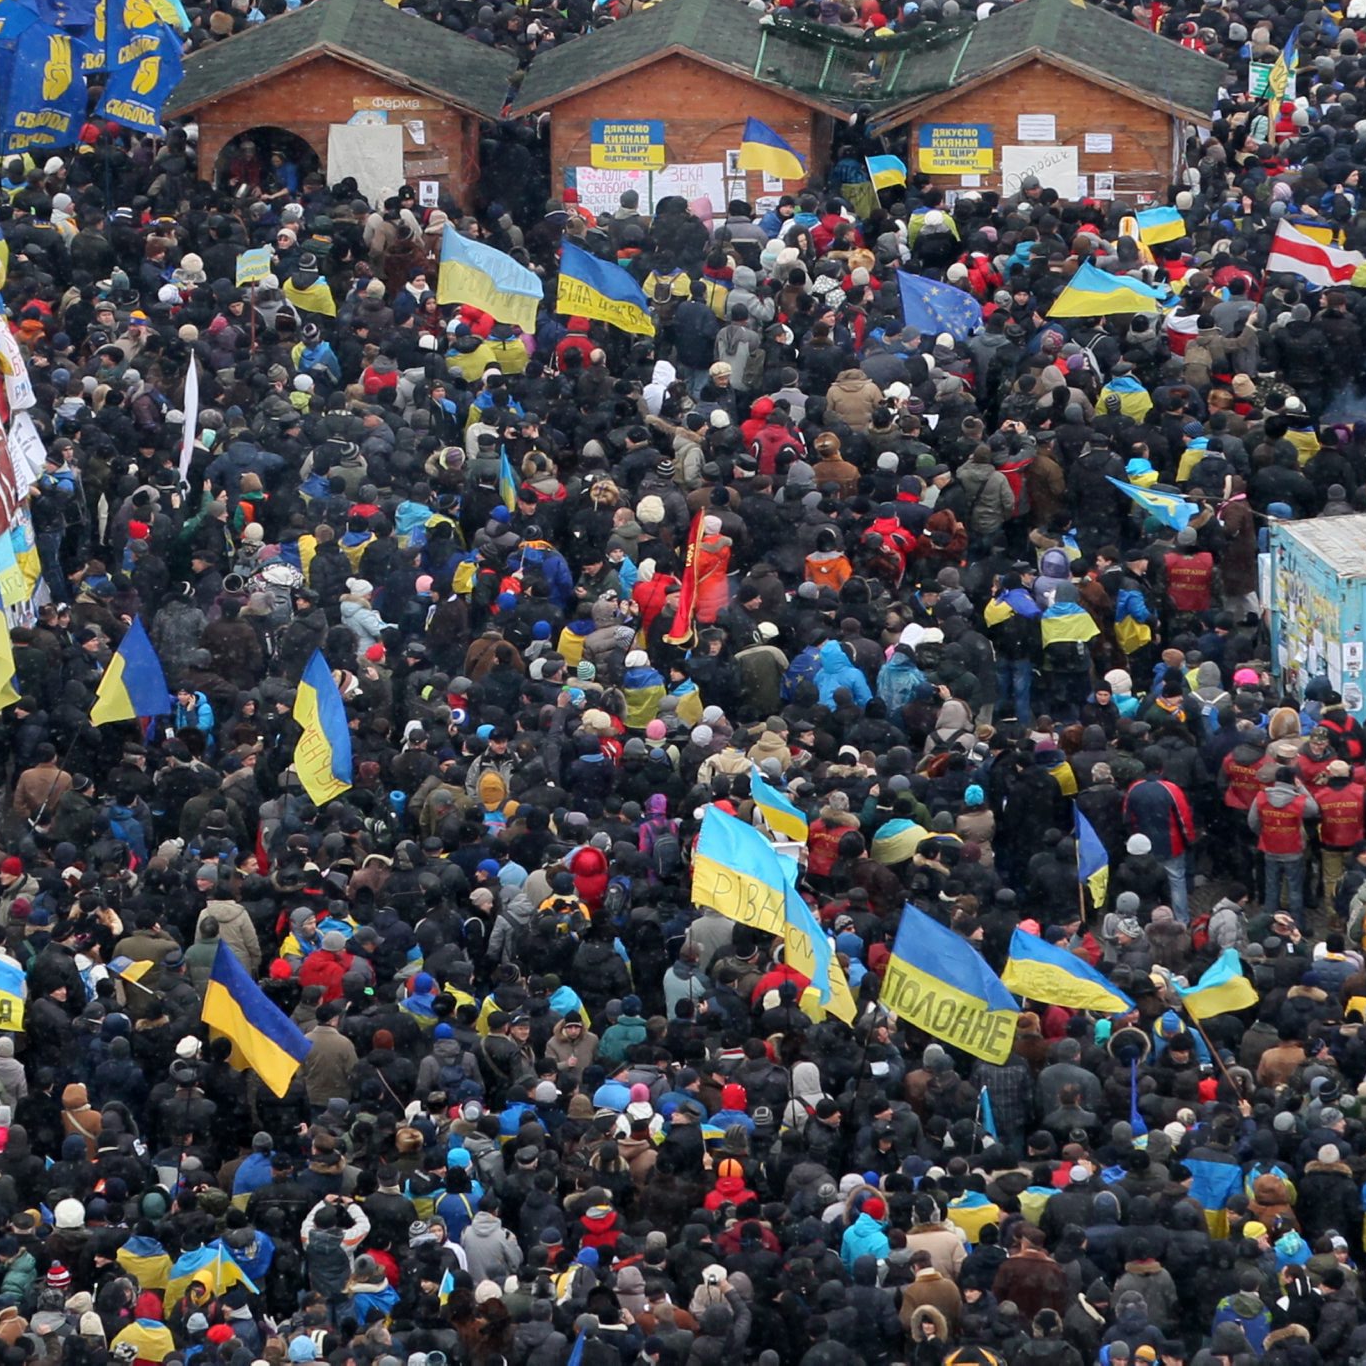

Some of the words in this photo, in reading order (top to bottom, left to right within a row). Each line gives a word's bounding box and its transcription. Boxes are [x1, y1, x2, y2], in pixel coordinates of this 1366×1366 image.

[372, 96, 422, 114] Ферма
[603, 123, 650, 135] ДЯКУЄМО
[931, 128, 979, 139] ДЯКУЄМО
[603, 135, 650, 145] КИЯНАМ
[931, 139, 979, 149] КИЯНАМ
[604, 145, 618, 155] ЗА
[621, 145, 649, 156] ЩИРУ
[932, 149, 945, 158] ЗА
[948, 149, 978, 160] ЩИРУ
[885, 967, 1013, 1057] ПОЛОННЕ
